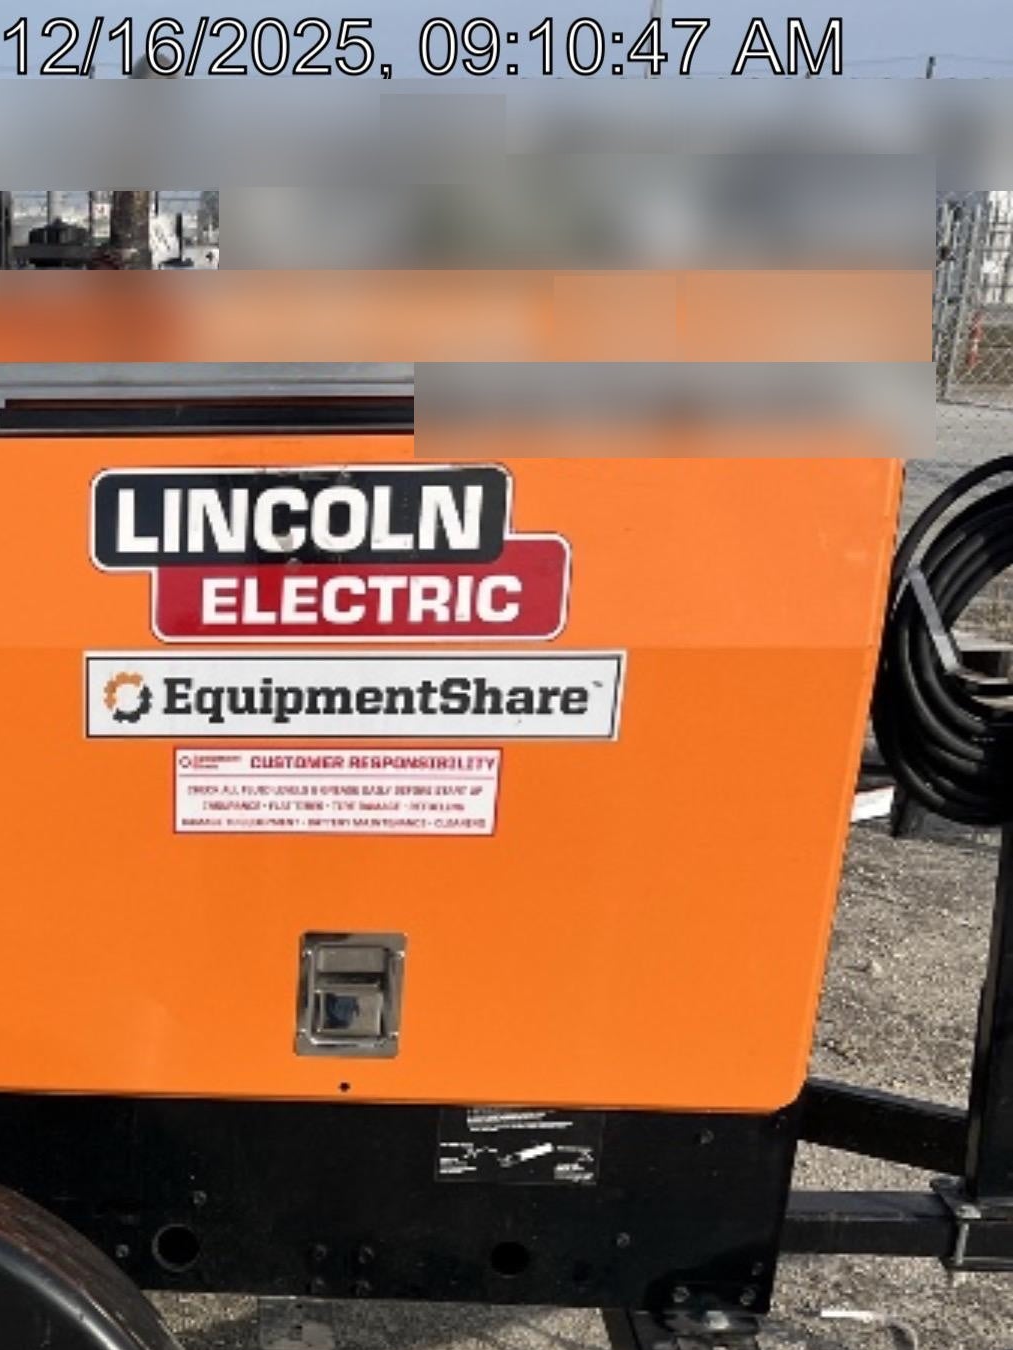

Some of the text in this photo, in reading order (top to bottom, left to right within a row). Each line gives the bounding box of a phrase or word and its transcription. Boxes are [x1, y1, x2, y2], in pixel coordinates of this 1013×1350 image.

[115, 484, 485, 555] LINCOLN
[201, 574, 523, 625] ELECTRIC
[249, 755, 345, 769] CUSTOMER
